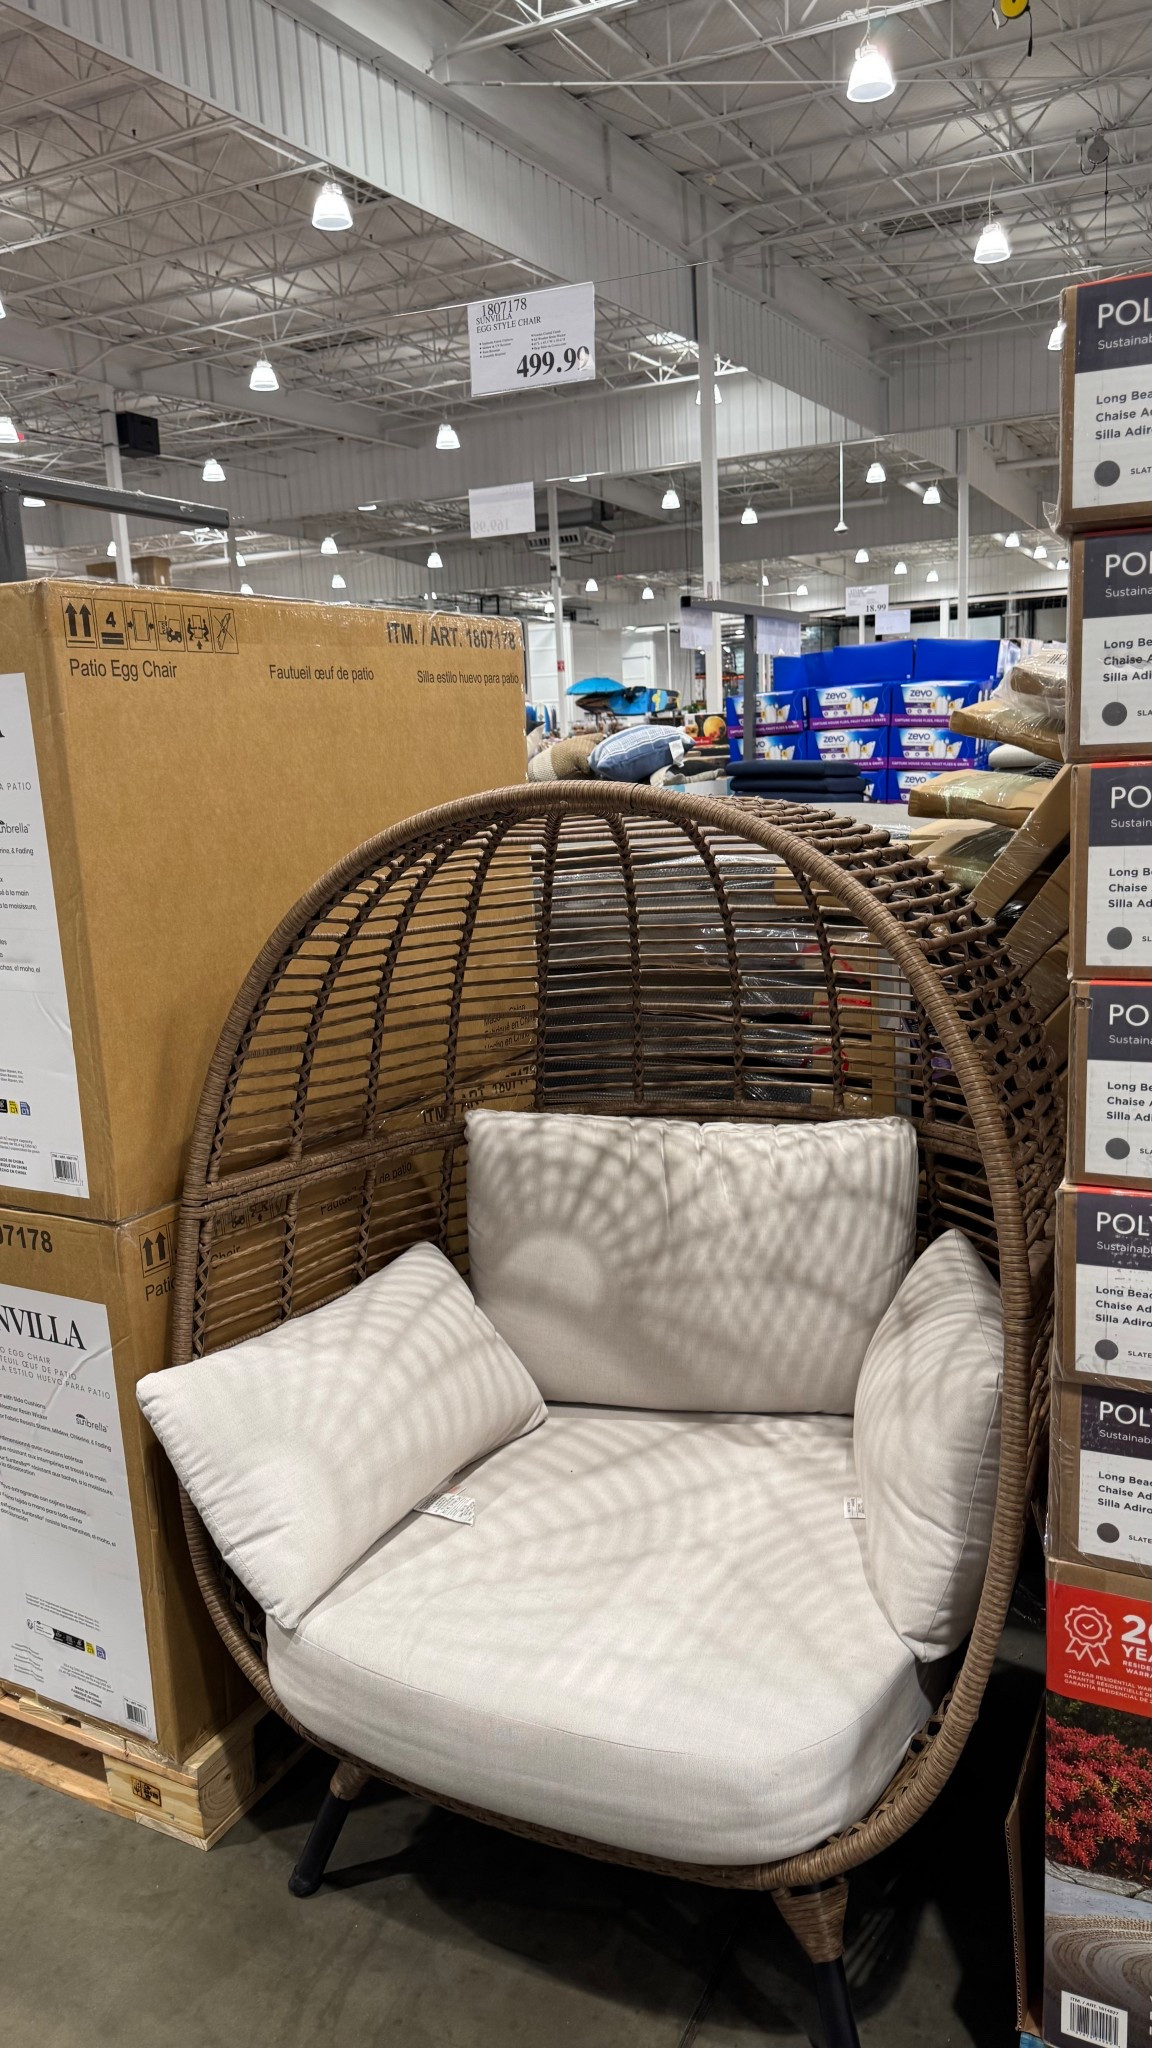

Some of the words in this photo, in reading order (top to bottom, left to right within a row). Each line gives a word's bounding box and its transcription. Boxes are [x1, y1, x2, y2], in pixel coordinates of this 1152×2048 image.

[482, 297, 527, 317] 1807178
[475, 313, 513, 326] SUNVILLA
[476, 324, 492, 334] EGG
[493, 320, 517, 331] STYLE
[517, 316, 542, 327] CHAIR
[516, 345, 590, 378] 499.99
[1096, 393, 1127, 405] Long
[1096, 409, 1137, 422] Chaise
[1095, 428, 1121, 441] Silla
[1124, 425, 1152, 437] Adir
[865, 603, 887, 613] 18.99
[386, 621, 418, 644] ITM.
[430, 627, 463, 648] ART.
[466, 630, 516, 650] 1807178
[1103, 639, 1134, 650] Long
[1103, 654, 1143, 666] Chaise
[70, 658, 107, 678] Patio
[110, 659, 139, 681] Egg
[142, 659, 178, 679] Chair
[269, 665, 312, 680] Fautueil
[314, 665, 334, 680] œuf
[336, 668, 349, 681] de
[351, 668, 375, 684] patio
[416, 670, 435, 684] Silla
[436, 671, 458, 684] estilo
[459, 671, 482, 684] huevo
[484, 673, 501, 687] para
[501, 672, 519, 687] patio
[1102, 671, 1128, 682] Silla
[825, 691, 847, 701] zevo
[909, 689, 933, 698] zevo
[823, 734, 845, 744] zevo
[907, 732, 931, 741] zevo
[7, 781, 32, 791] PATIO
[904, 775, 927, 784] zevo
[1109, 868, 1139, 878] Long
[1108, 883, 1148, 892] Chaise
[1107, 899, 1132, 908] Silla
[1107, 1081, 1136, 1092] Long
[1106, 1096, 1145, 1106] Chaise
[1106, 1111, 1131, 1121] Silla
[1095, 1285, 1124, 1298] Long
[1095, 1299, 1133, 1312] Chaise
[1095, 1313, 1119, 1324] Silla
[8, 1347, 24, 1358] EGG
[27, 1353, 51, 1365] CHAIR
[41, 1365, 52, 1374] DE
[54, 1367, 77, 1381] PATIO
[9, 1366, 34, 1380] ESTILO
[36, 1371, 63, 1386] HUEVO
[65, 1380, 86, 1393] PARA
[87, 1385, 111, 1400] PATIO
[1098, 1470, 1125, 1484] Long
[1098, 1484, 1134, 1498] Chaise
[1097, 1497, 1121, 1510] Silla
[1121, 1614, 1152, 1646] 2
[1064, 1673, 1095, 1685] GARANTIE
[1068, 1668, 1094, 1679] 20-YEAR
[1095, 1674, 1137, 1688] RESIDENTIAL
[1097, 1687, 1137, 1701] RESIDENCIAL
